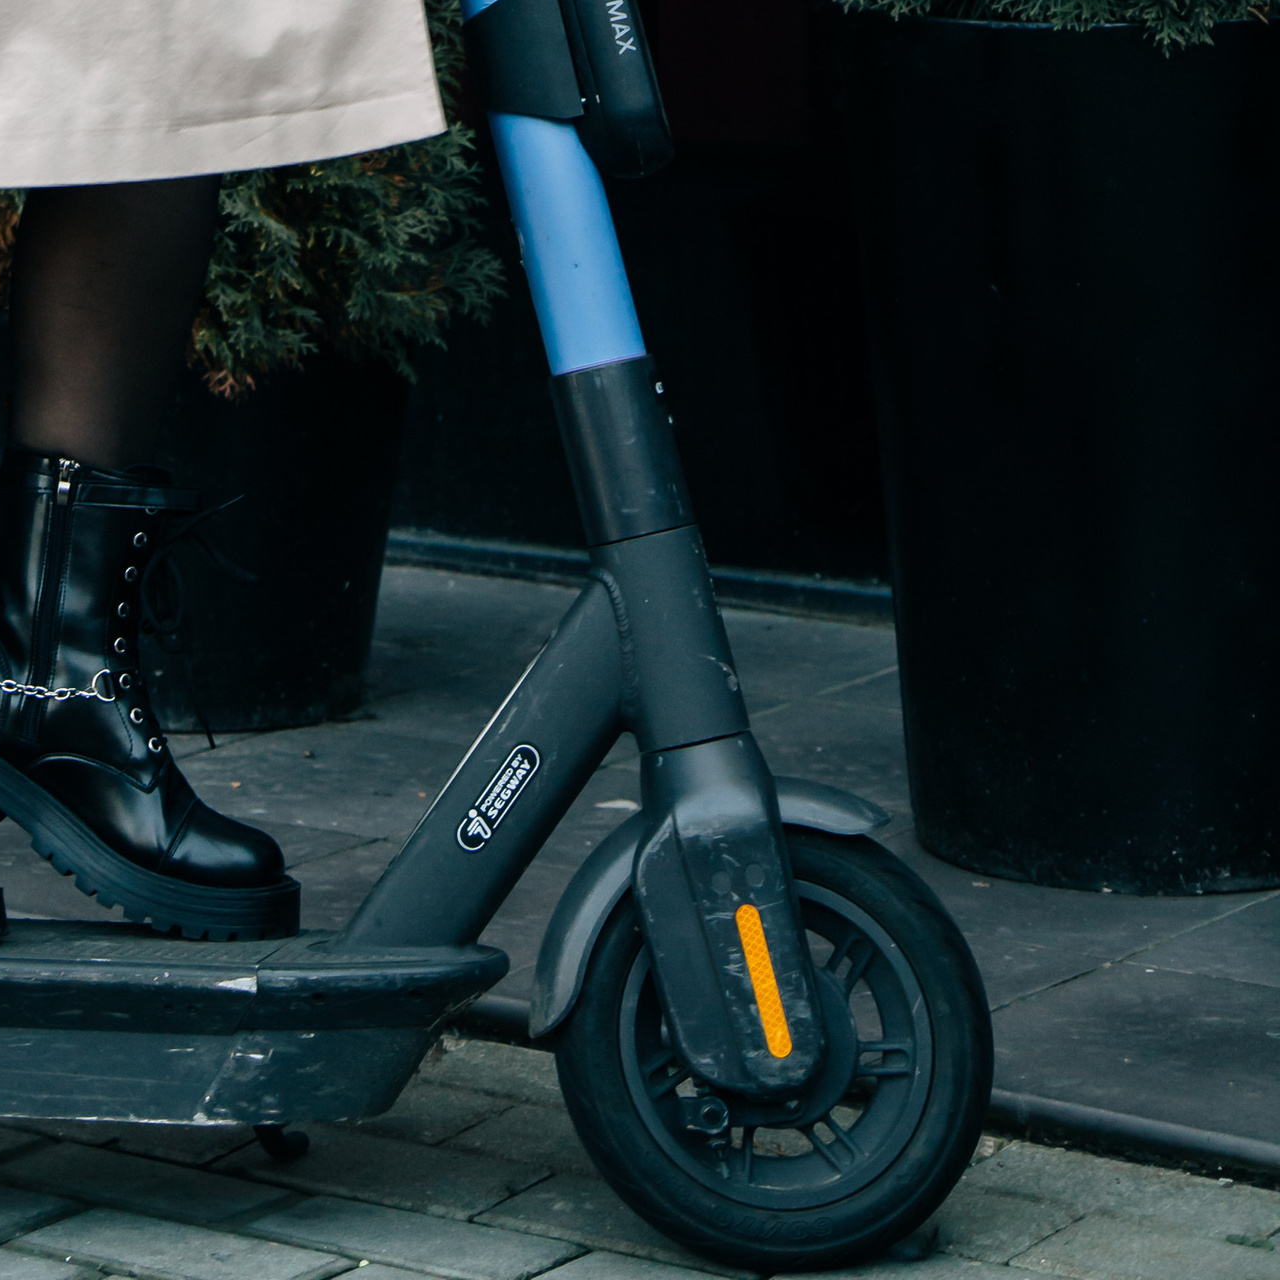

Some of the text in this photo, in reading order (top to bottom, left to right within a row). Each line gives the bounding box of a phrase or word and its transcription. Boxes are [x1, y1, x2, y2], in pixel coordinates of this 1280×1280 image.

[480, 753, 523, 812] POWERED BY
[487, 758, 531, 819] SEGWAY
